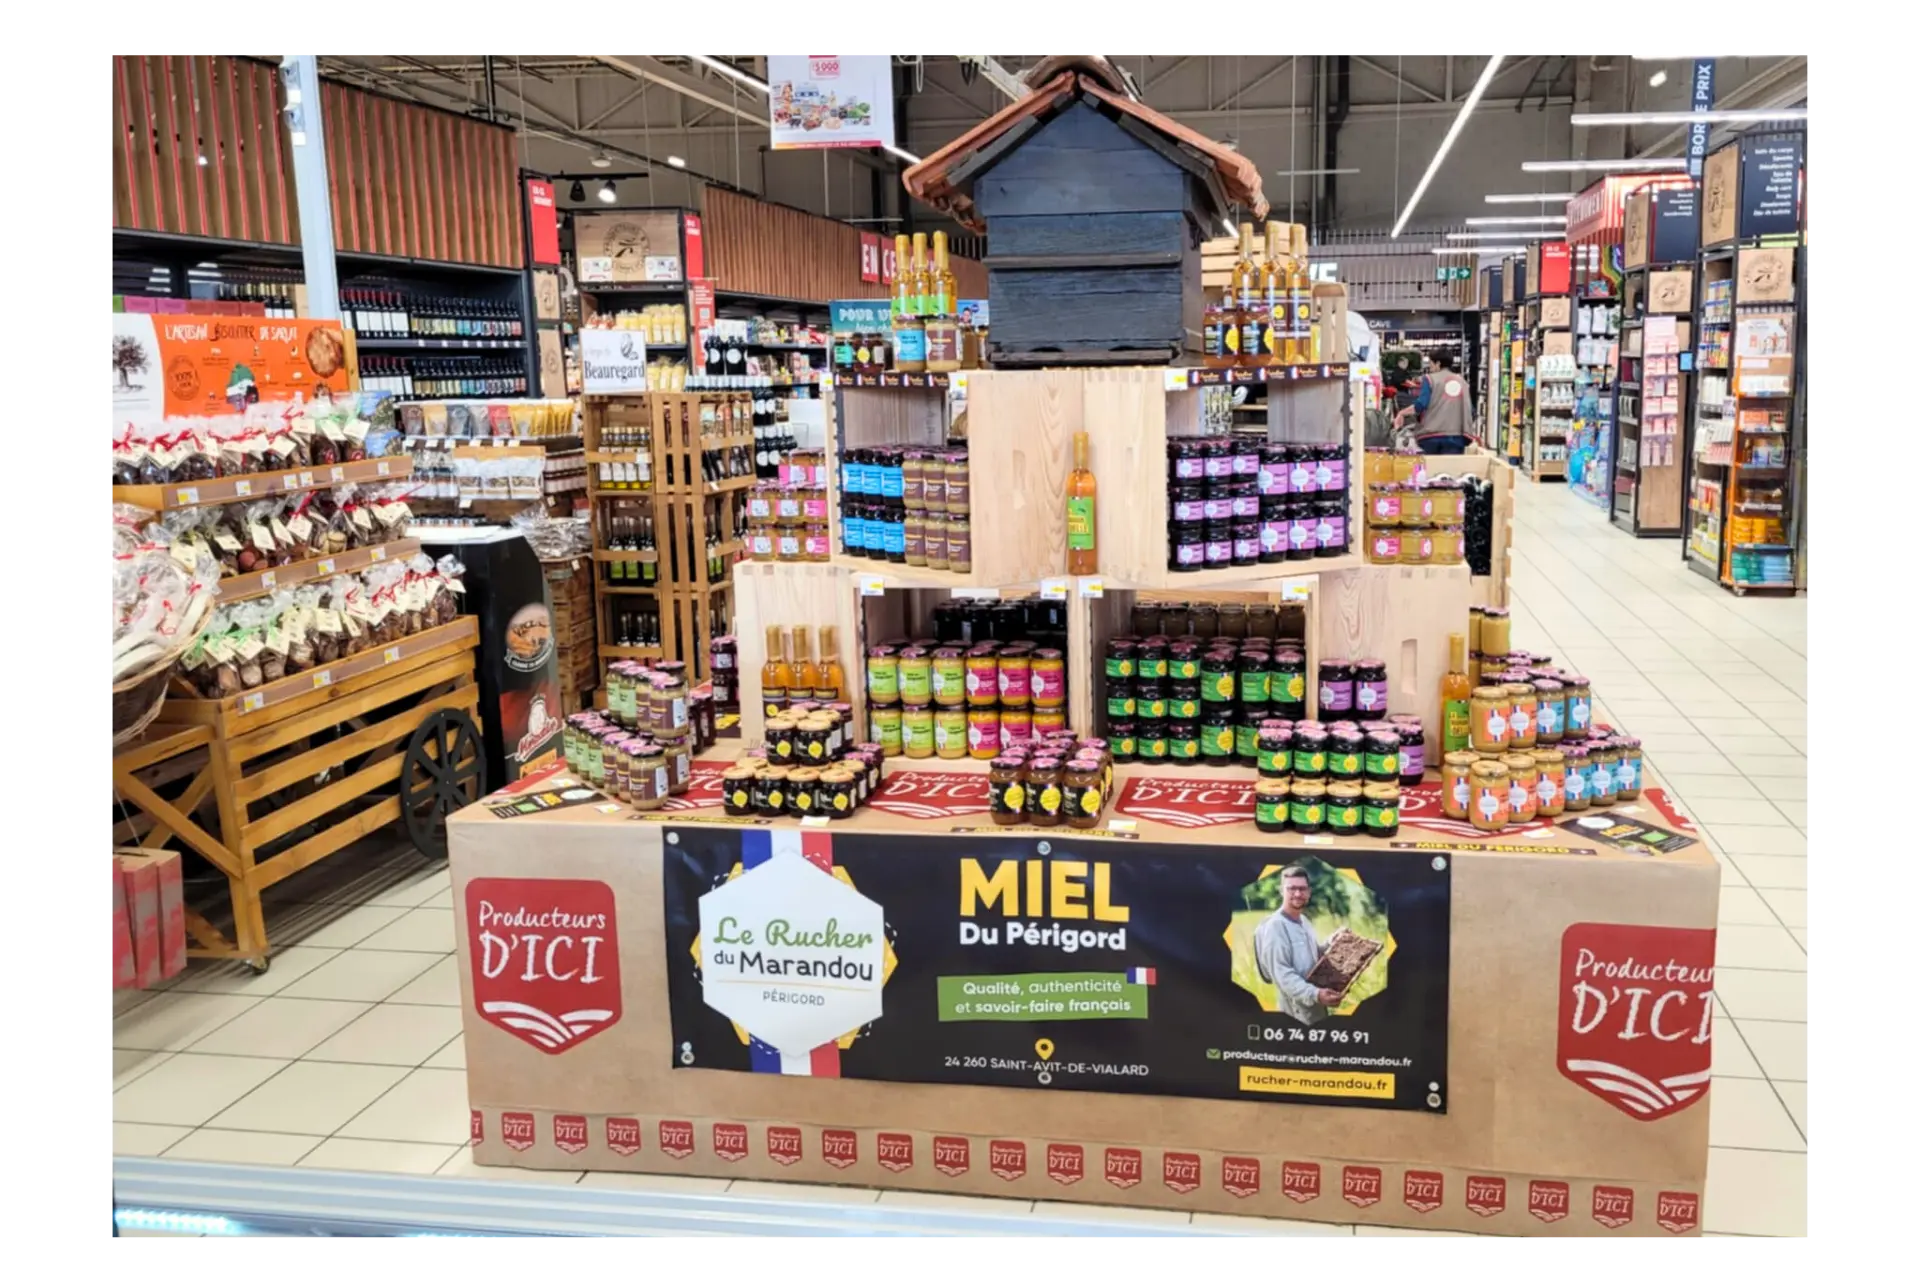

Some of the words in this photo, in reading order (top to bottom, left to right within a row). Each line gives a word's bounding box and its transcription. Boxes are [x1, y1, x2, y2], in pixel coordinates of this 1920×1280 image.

[1696, 65, 1711, 100] PRIX
[1692, 104, 1708, 155] BORE
[839, 308, 874, 322] POUR
[584, 360, 645, 383] Beauregard
[960, 858, 1130, 923] MIEL
[479, 900, 606, 929] Producteurs
[713, 916, 754, 945] Le
[765, 917, 873, 948] Rucher
[960, 922, 999, 945] Du
[1006, 921, 1127, 953] Périgord
[479, 929, 604, 984] D'ICI
[714, 950, 735, 965] du
[739, 950, 873, 982] Marandou
[1575, 948, 1714, 983] Producteur
[963, 981, 1024, 996] Qualité,
[1029, 979, 1123, 994] authenticité
[763, 988, 825, 1006] PÉRIGORD
[955, 1002, 970, 1013] et
[975, 1000, 1064, 1014] savoir-faire
[1069, 998, 1131, 1014] français
[1572, 980, 1714, 1044] D'ICI
[1263, 1027, 1284, 1041] 06
[1288, 1028, 1305, 1041] 74
[1308, 1029, 1327, 1042] 87
[1330, 1030, 1349, 1043] 96
[1353, 1031, 1369, 1044] 91
[944, 1056, 960, 1067] 24
[963, 1057, 988, 1068] 260
[990, 1059, 1149, 1076] SAINT-AVIT-DE-VIALARD
[1246, 1073, 1388, 1090] rucher-marandou.fr
[504, 1124, 532, 1136] D'ICI
[556, 1127, 584, 1139] D'ICI
[609, 1130, 638, 1142] D'ICI
[662, 1132, 691, 1144] D'ICI
[715, 1135, 745, 1148] D'ICI
[769, 1139, 799, 1152] D'ICI
[825, 1142, 855, 1155] D'ICI
[879, 1145, 910, 1158] D'ICI
[936, 1150, 967, 1163] D'ICI
[992, 1153, 1024, 1167] D'ICI
[1049, 1156, 1081, 1170] D'ICI
[1106, 1160, 1138, 1174] D'ICI
[1166, 1165, 1198, 1179] D'ICI
[1225, 1169, 1257, 1183] D'ICI
[1285, 1174, 1317, 1188] D'ICI
[1345, 1180, 1378, 1195] D'ICI
[1407, 1183, 1440, 1198] D'ICI
[1469, 1190, 1502, 1205] D'ICI
[1531, 1196, 1566, 1211] D'ICI
[1595, 1199, 1629, 1214] D'ICI
[1660, 1205, 1694, 1220] D'ICI
